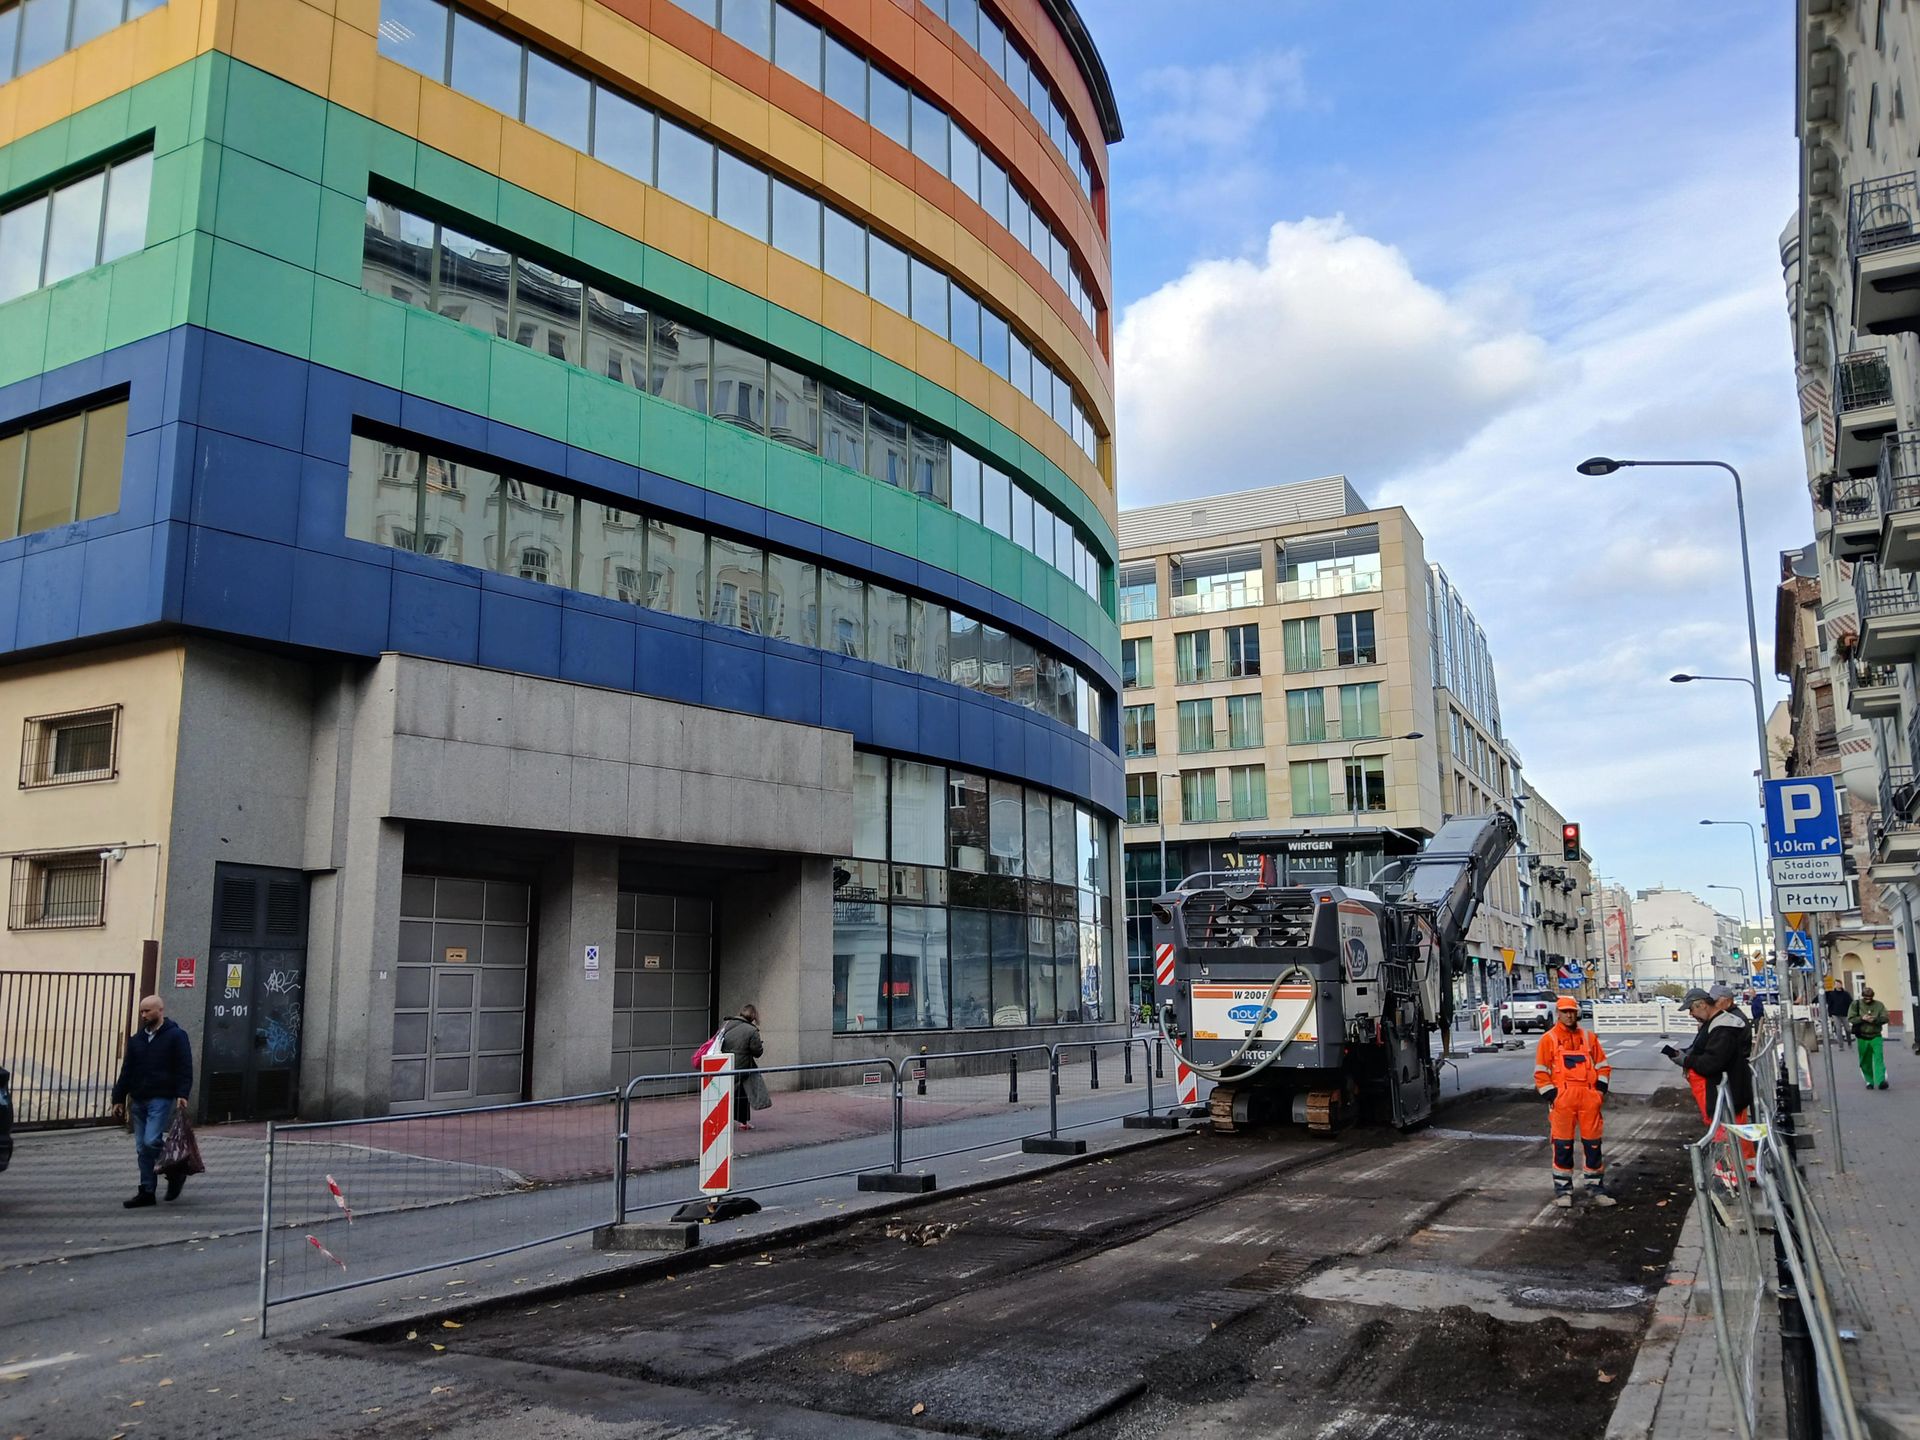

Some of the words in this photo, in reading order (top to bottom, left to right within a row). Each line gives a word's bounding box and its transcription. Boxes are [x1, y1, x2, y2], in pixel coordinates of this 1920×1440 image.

[1780, 784, 1822, 834] P
[1288, 841, 1333, 851] WIRTGEN
[1784, 859, 1830, 869] Stadion
[1778, 870, 1838, 881] Narodowy
[1787, 893, 1839, 908] Płatny
[224, 988, 240, 999] SN
[1234, 991, 1243, 1000] W
